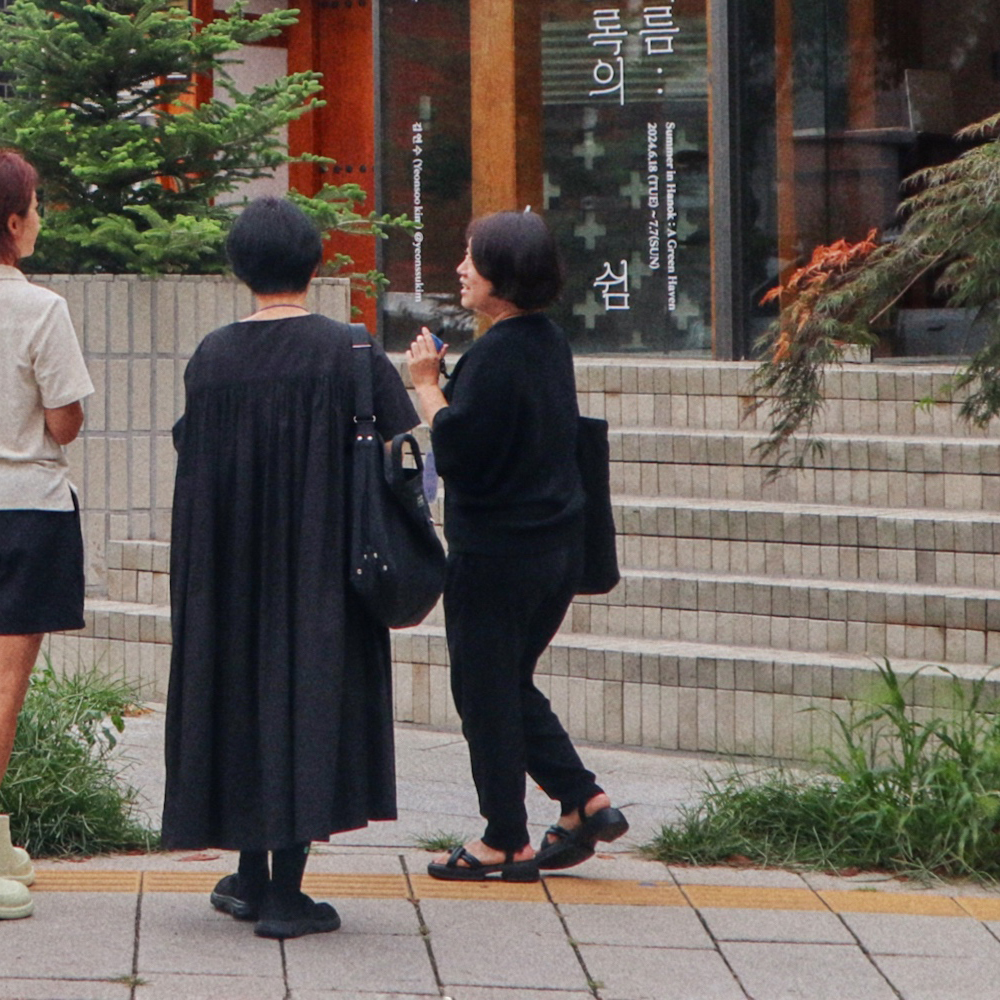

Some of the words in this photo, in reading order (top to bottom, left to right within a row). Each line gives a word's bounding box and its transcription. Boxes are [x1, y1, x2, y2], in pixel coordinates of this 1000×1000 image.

[648, 123, 658, 172] 2024.6.18
[666, 122, 676, 169] Summer
[413, 158, 423, 204] (Yeonsoo
[648, 175, 659, 208] (TUE)
[667, 171, 676, 182] in
[667, 184, 677, 220] Hanok
[667, 228, 677, 237] A
[413, 232, 423, 302] @yeonssukim
[667, 239, 677, 273] Green
[593, 260, 630, 311] 쉼
[667, 275, 677, 310] Haven
